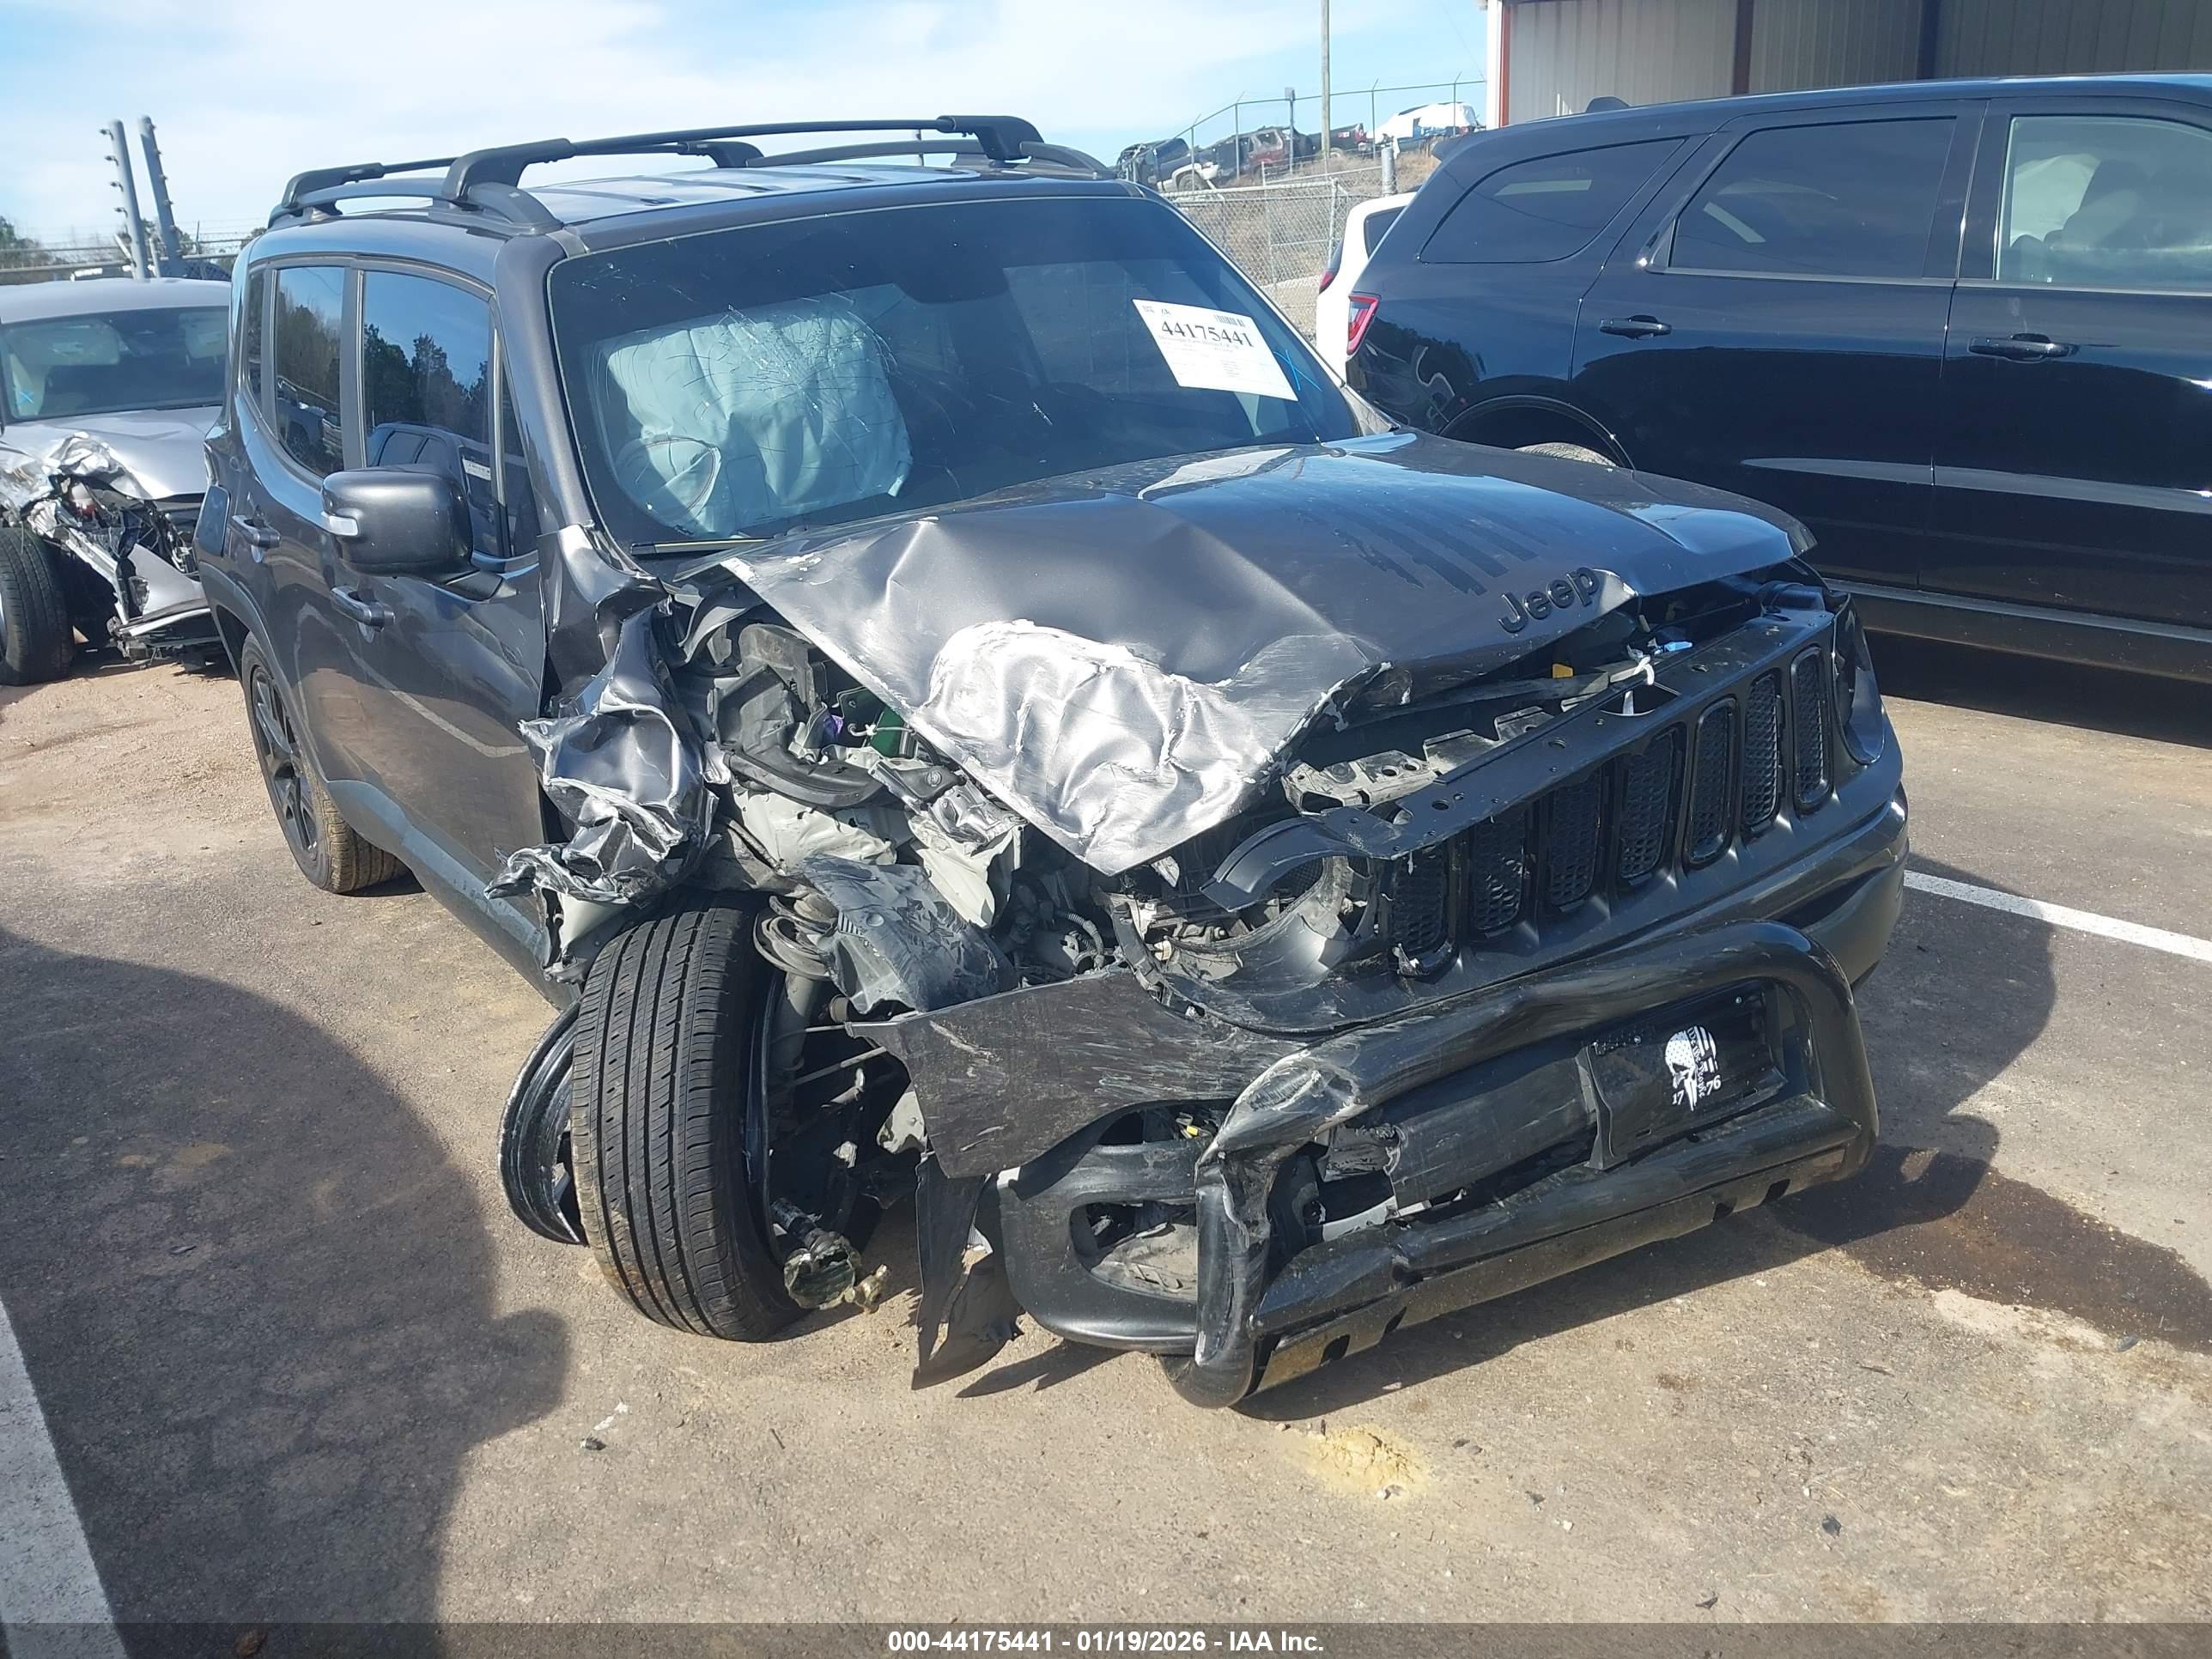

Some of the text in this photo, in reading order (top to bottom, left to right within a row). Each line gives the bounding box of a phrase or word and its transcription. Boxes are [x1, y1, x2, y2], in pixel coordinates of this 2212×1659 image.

[1162, 321, 1254, 347] 44175441
[1497, 567, 1600, 633] Jeep
[1672, 1074, 1721, 1105] 17 76
